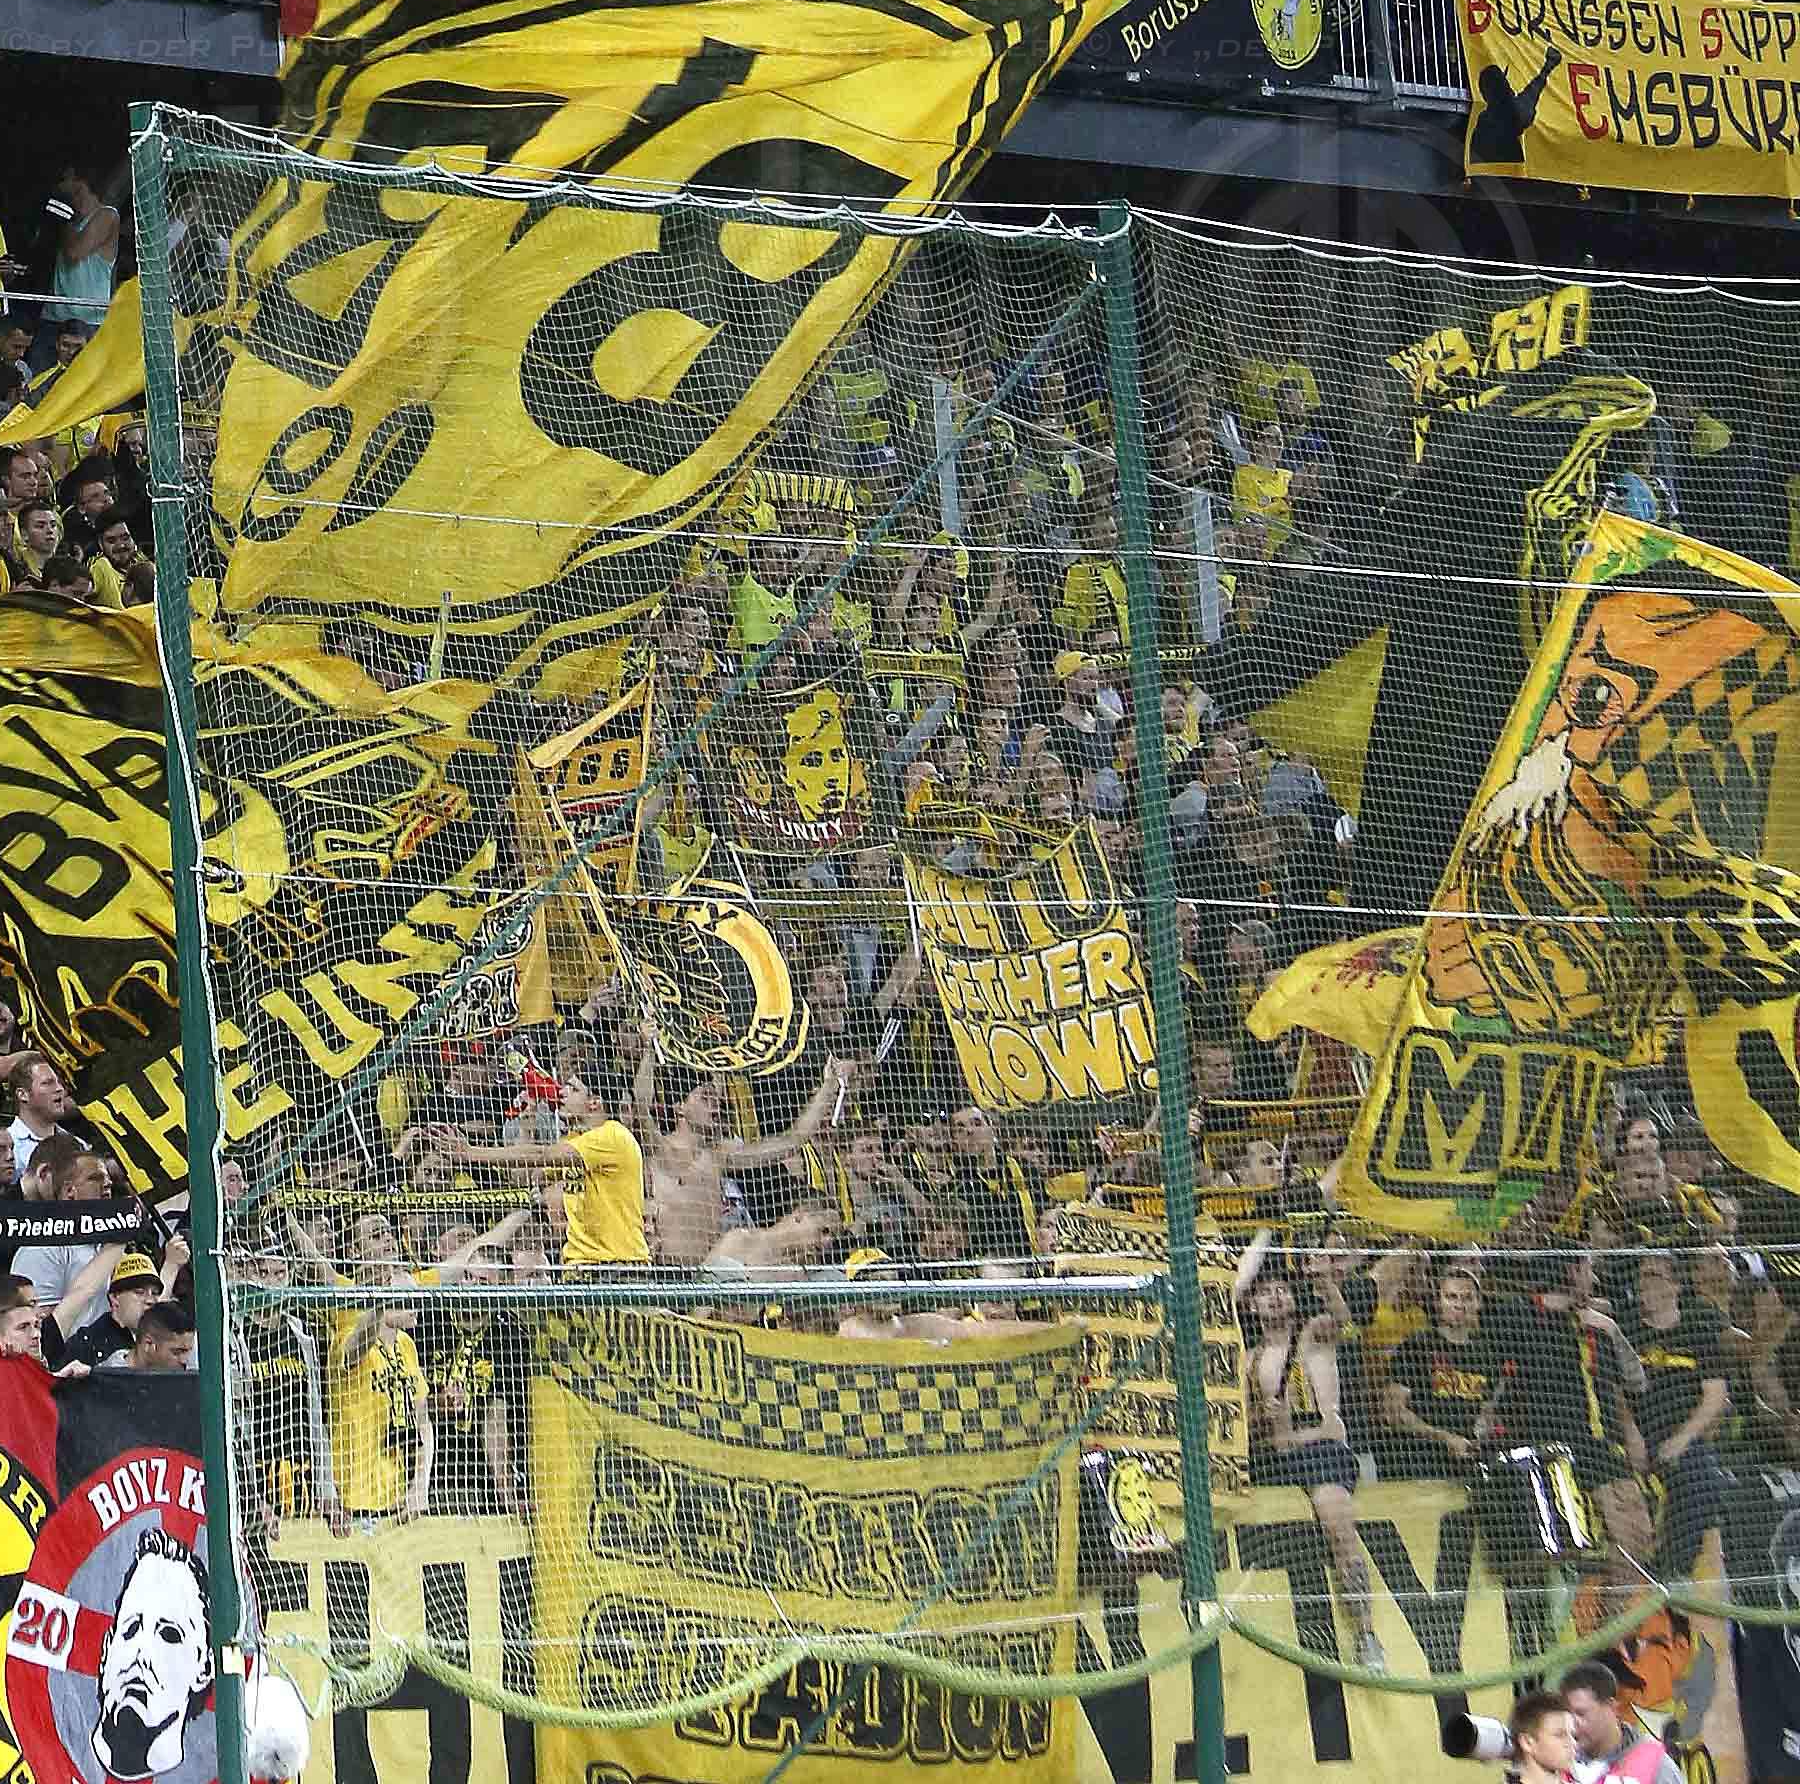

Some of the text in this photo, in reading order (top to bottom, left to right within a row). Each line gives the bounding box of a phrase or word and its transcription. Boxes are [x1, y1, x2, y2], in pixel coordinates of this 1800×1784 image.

[1699, 5, 1800, 63] SUPP
[1568, 61, 1800, 156] EMSBÜR
[951, 1002, 1161, 1111] NOW!
[6, 1215, 75, 1238] Frieden
[86, 1455, 171, 1532] BOYZ
[10, 1595, 72, 1656] 20
